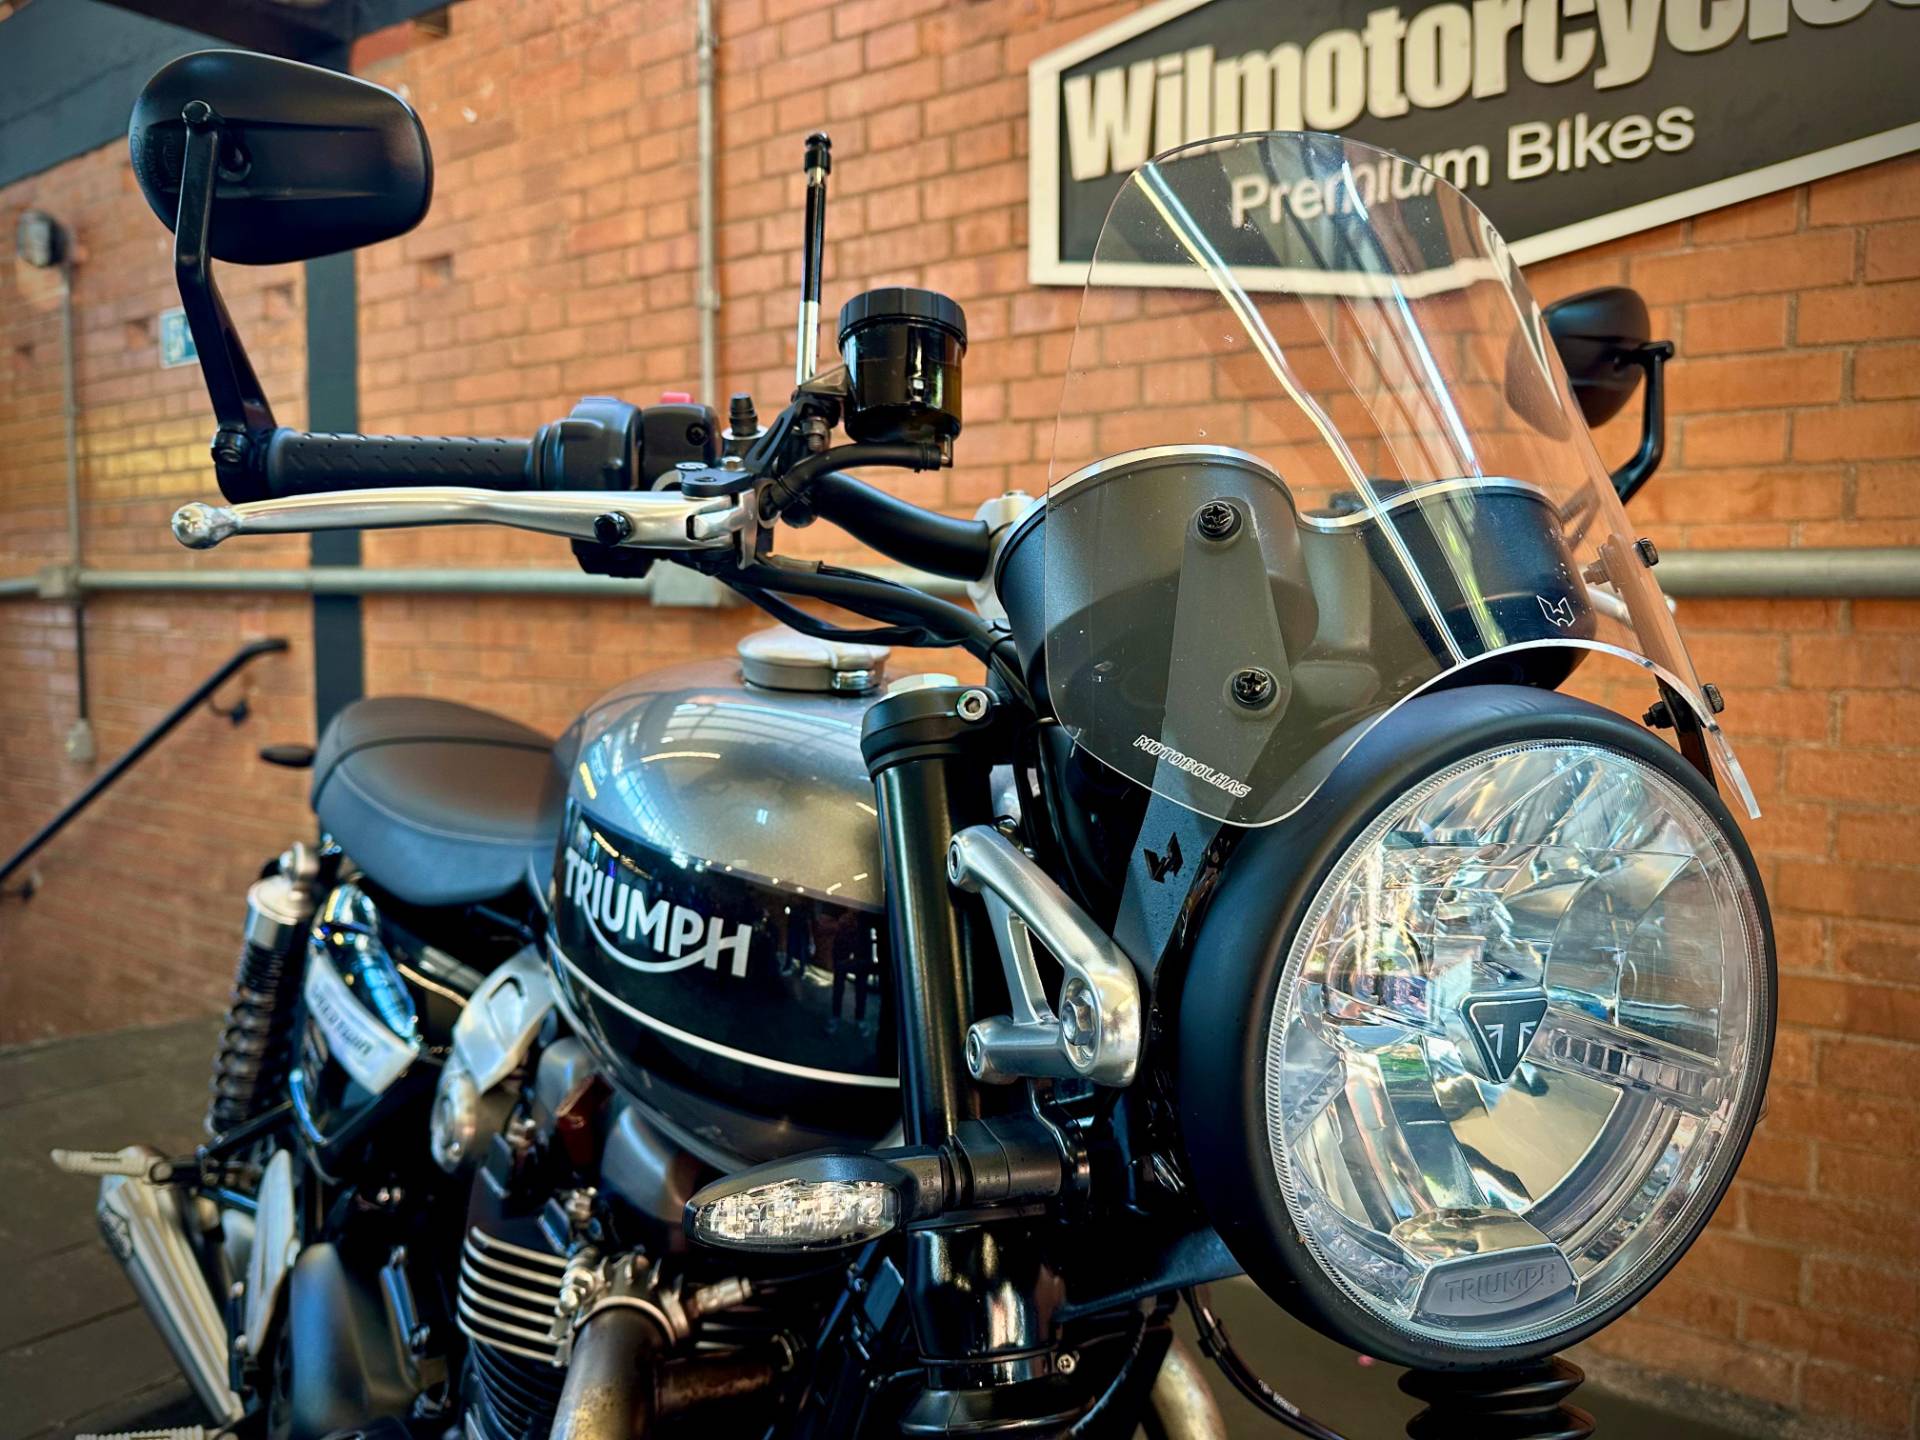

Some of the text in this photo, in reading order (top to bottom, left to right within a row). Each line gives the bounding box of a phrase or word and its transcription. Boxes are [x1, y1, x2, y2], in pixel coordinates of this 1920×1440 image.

[1064, 0, 1920, 181] Wilmotorcyc
[1231, 145, 1490, 228] Premium
[1133, 734, 1252, 798] MOTOBOLHAS
[565, 847, 752, 978] TRIUMPH
[1445, 1261, 1557, 1304] TRIUMPH
